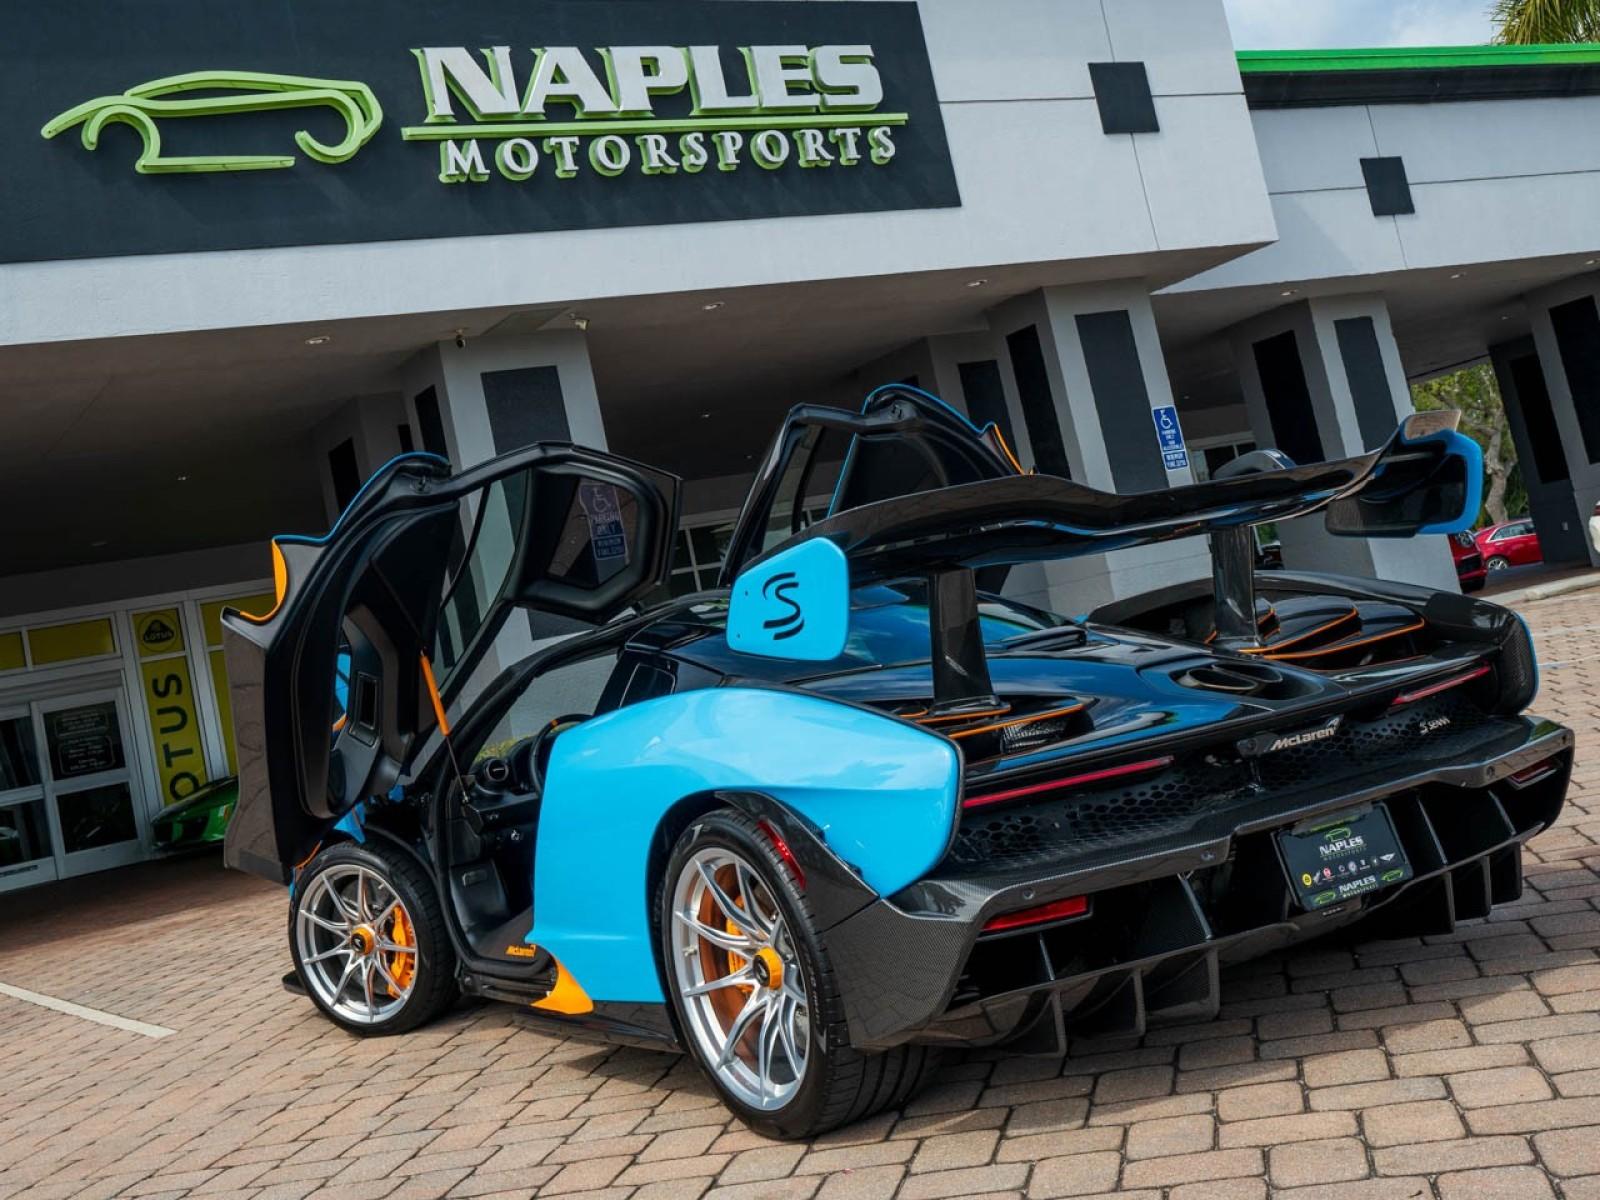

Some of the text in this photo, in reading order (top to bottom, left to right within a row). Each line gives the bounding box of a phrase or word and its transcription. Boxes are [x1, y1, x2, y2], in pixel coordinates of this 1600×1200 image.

[410, 43, 884, 122] NAPLES
[438, 126, 897, 185] MOTORSPORTS
[152, 673, 200, 800] OTUS
[1270, 727, 1336, 751] McLaren
[1319, 835, 1365, 855] NAPLES
[1339, 875, 1377, 893] NAPLES
